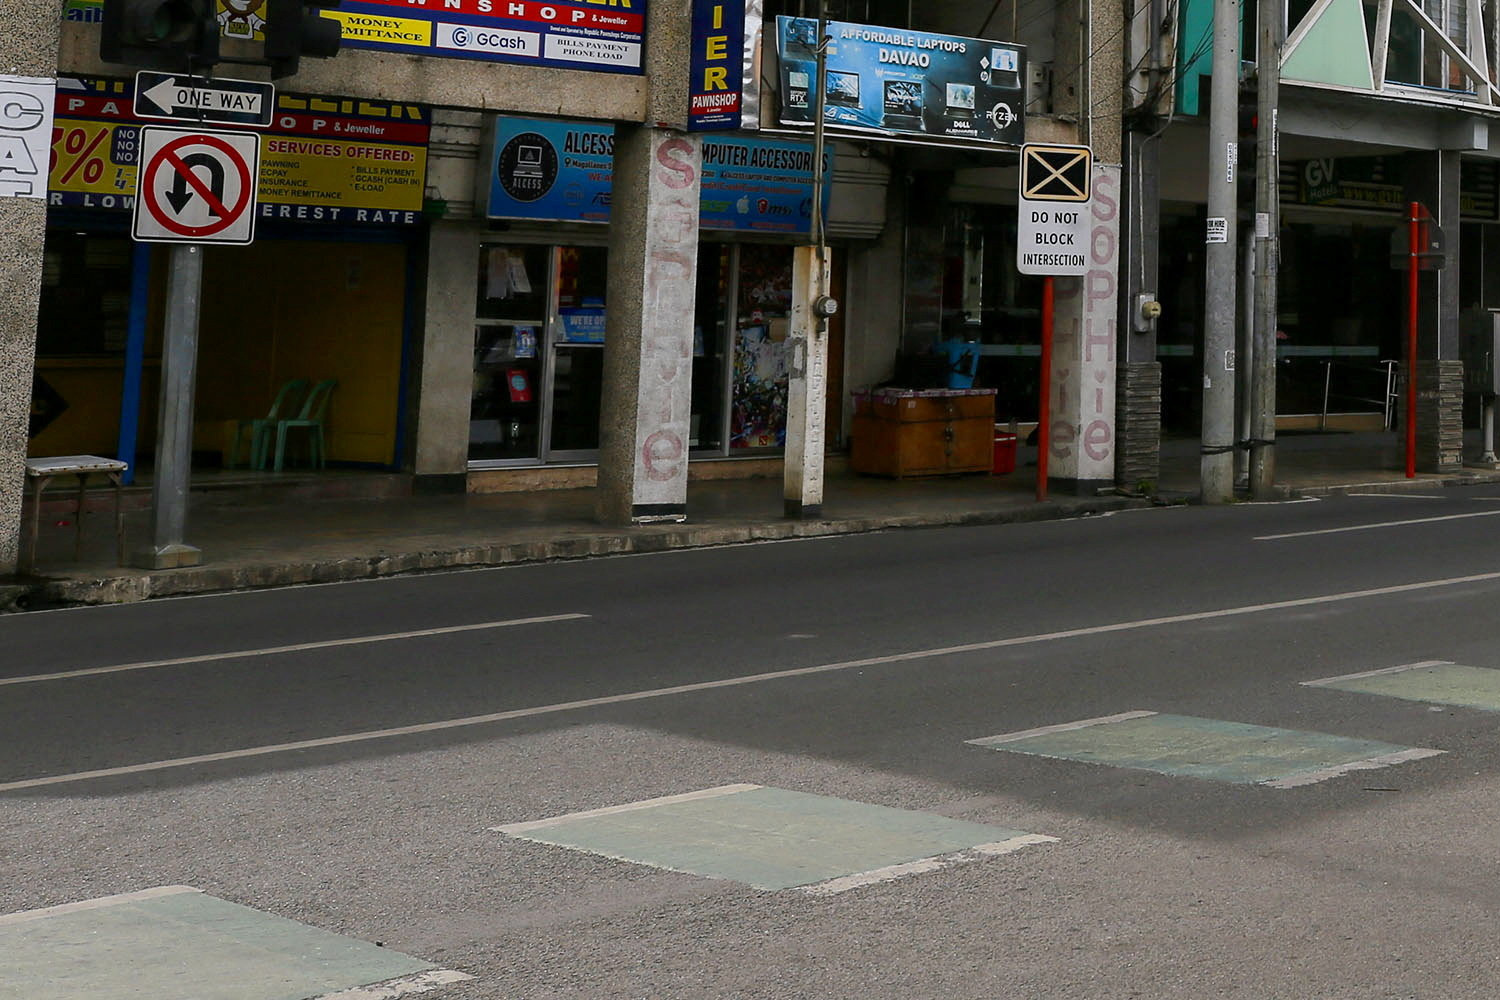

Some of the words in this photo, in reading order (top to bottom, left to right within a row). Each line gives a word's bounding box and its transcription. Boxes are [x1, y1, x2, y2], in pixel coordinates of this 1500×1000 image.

[347, 16, 403, 30] MONEY
[598, 14, 629, 26] Jeweller
[339, 27, 424, 42] EMITTANCE
[840, 27, 914, 48] AFFORDABLE
[916, 37, 967, 54] LAPTOPS
[476, 33, 526, 50] GCash
[557, 39, 584, 47] BILLS
[586, 42, 629, 52] PAYMENT
[563, 48, 595, 57] PHONE
[597, 52, 623, 60] LOAD
[878, 47, 930, 68] DAVAO
[177, 89, 213, 107] ONE
[220, 92, 257, 110] WAY
[692, 93, 737, 109] PAWNSHOP
[790, 95, 805, 103] RTX
[986, 110, 1018, 122] RYZEN
[343, 122, 385, 135] Jeweller
[953, 120, 970, 128] DELL
[118, 129, 136, 140] NO
[117, 140, 134, 151] NO
[267, 139, 342, 157] SERVICES
[346, 146, 414, 162] OFFERED:
[116, 151, 134, 163] NO
[702, 143, 748, 167] MPUTER
[750, 147, 829, 172] ACCESSORIS
[261, 160, 300, 169] PAWNING
[260, 168, 288, 177] ECPAY
[356, 166, 379, 175] BILLS
[380, 167, 416, 176] PAYMENT
[1305, 158, 1335, 187] GV
[259, 177, 309, 187] INSURANCE
[355, 175, 384, 184] GCASH
[512, 177, 542, 189] ALCESS
[259, 187, 289, 197] MONEY
[290, 189, 342, 199] REMITTANCE
[354, 183, 384, 192] E-LOAD
[262, 204, 341, 219] EREST
[357, 210, 414, 224] RATE
[1031, 211, 1049, 223] DO
[1054, 212, 1079, 224] NOT
[1035, 232, 1074, 245] BLOCK
[1023, 253, 1085, 266] INTERSECTION
